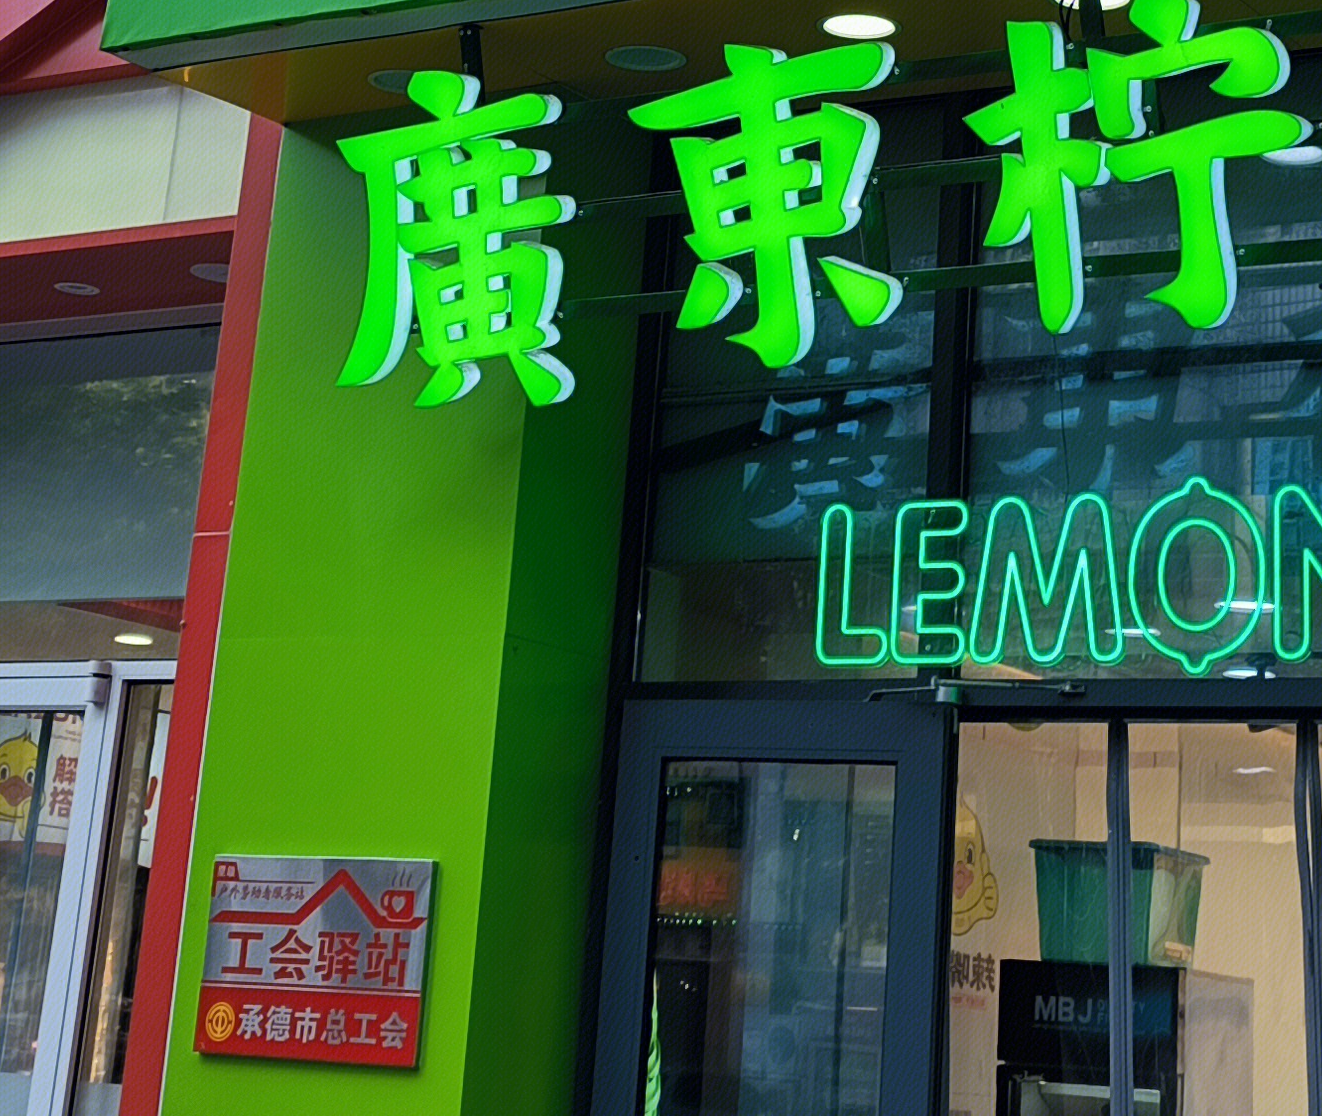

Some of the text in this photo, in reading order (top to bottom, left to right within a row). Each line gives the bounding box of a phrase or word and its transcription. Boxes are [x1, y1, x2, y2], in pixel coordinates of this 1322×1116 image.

[220, 927, 411, 988] 工会驿站
[236, 1004, 408, 1050] 承德市总工会
[1034, 995, 1093, 1024] MBJ
